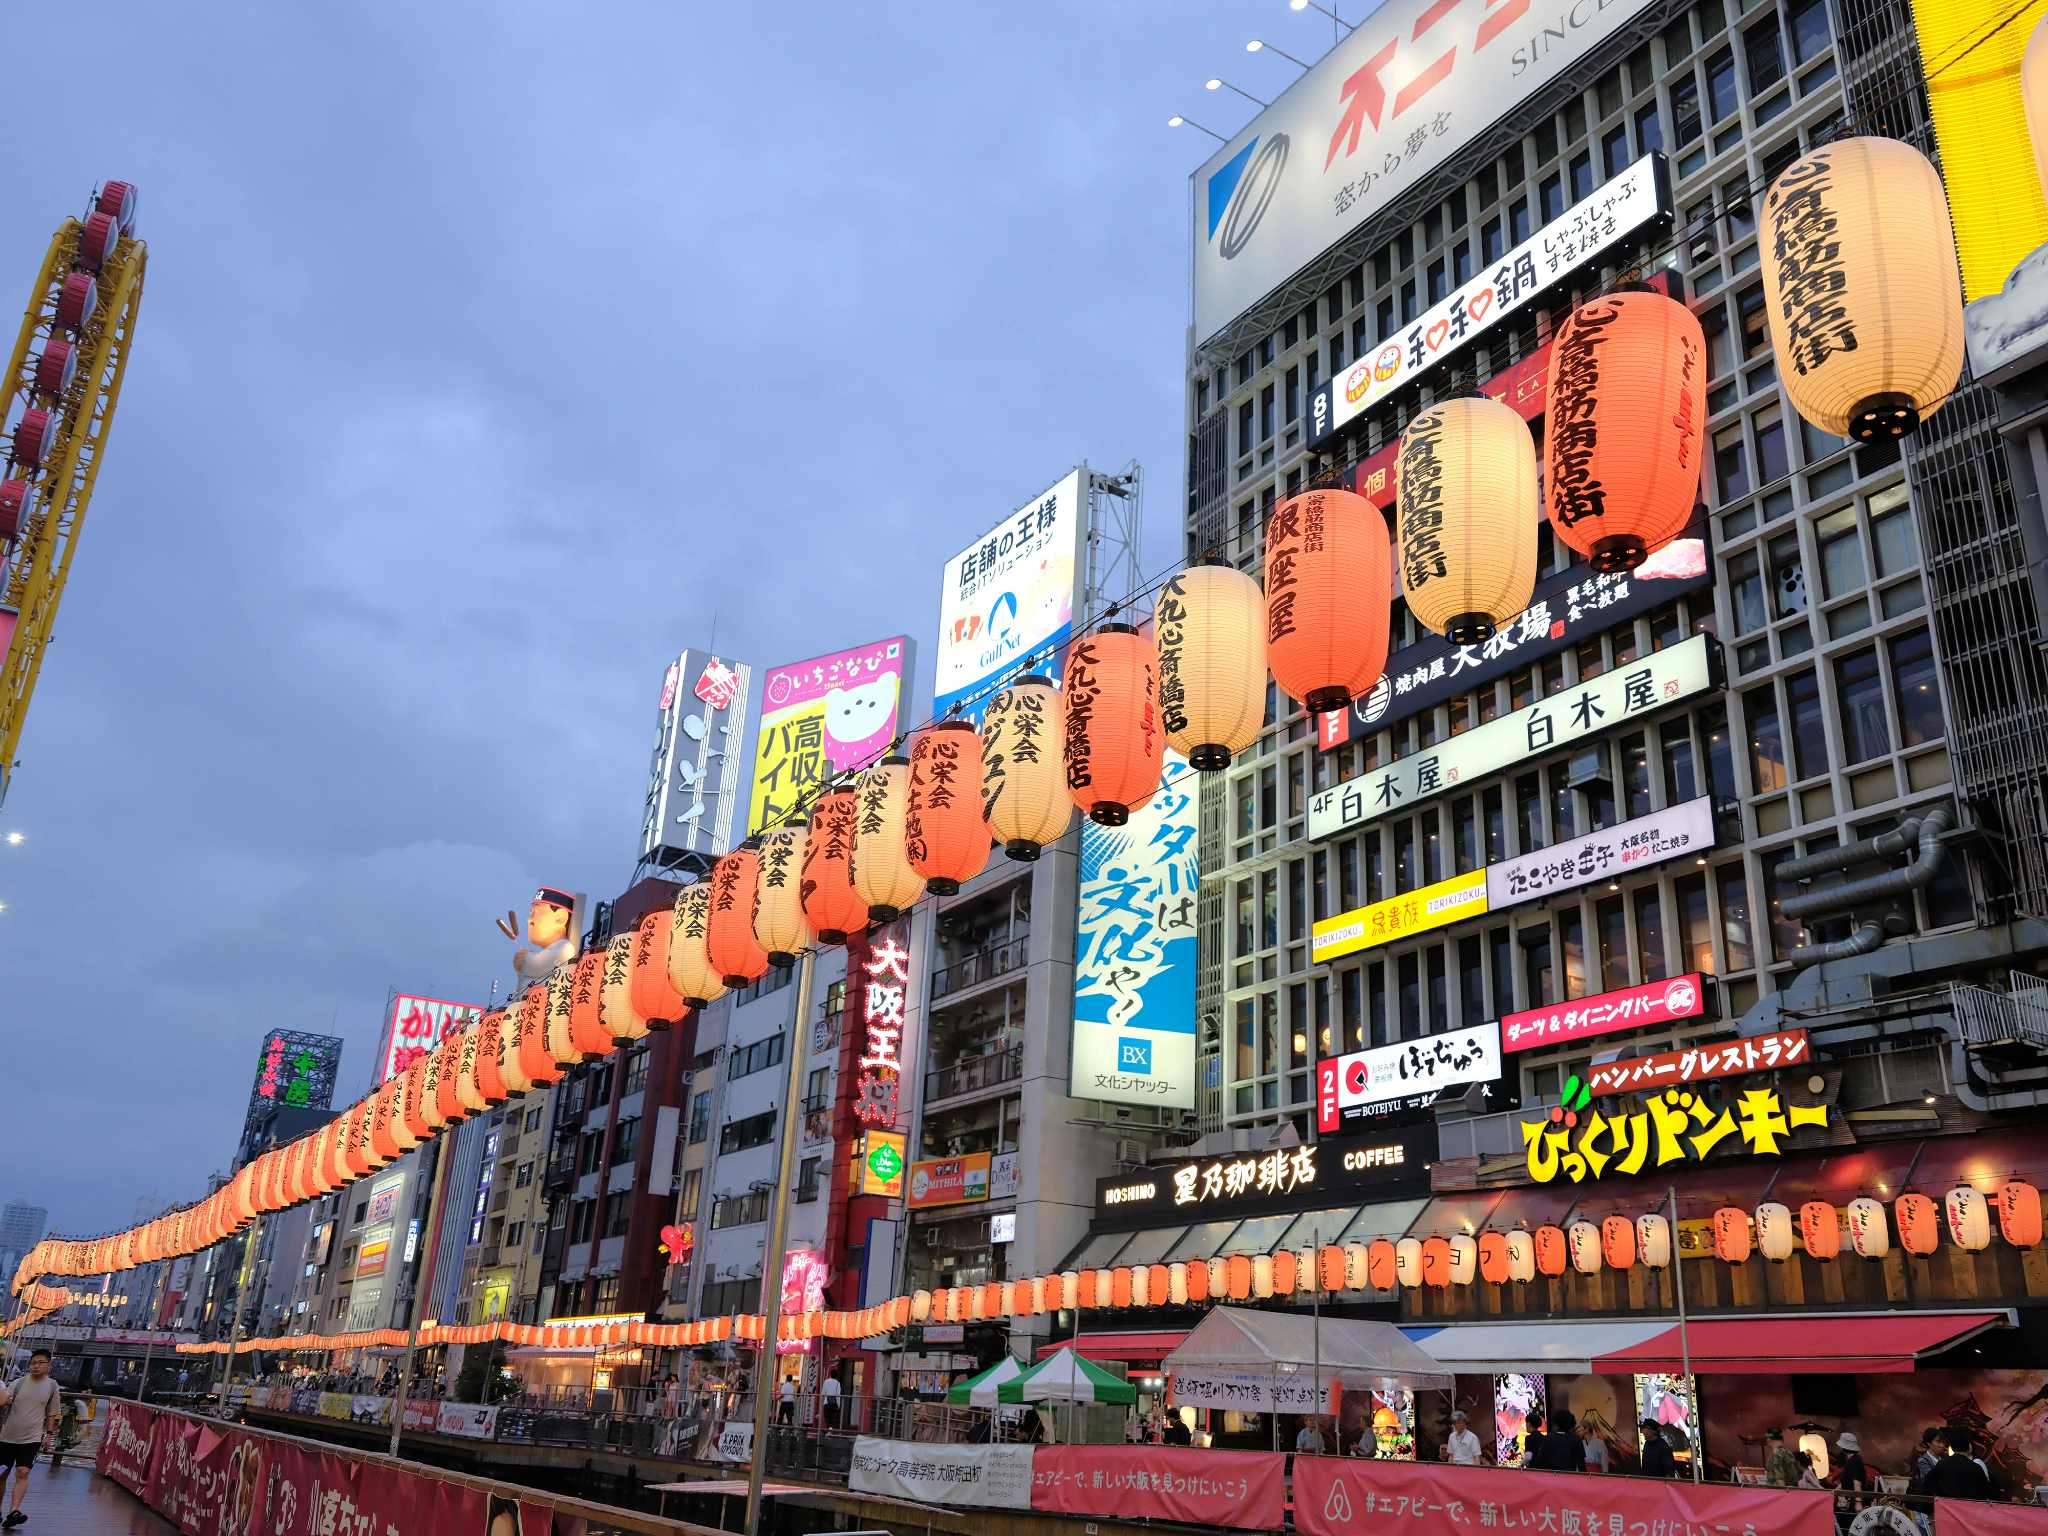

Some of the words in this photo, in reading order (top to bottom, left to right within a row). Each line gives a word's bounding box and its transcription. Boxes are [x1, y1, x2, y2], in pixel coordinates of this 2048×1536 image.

[1334, 111, 1453, 218] 窓から夢を
[1543, 174, 1639, 254] しゃぶしゃぶ
[1546, 216, 1617, 273] すき焼き
[1312, 391, 1328, 437] 8F
[959, 494, 1057, 588] 店舗の王様
[1267, 502, 1300, 645] 銀座屋
[1396, 655, 1446, 698] 焼肉屋
[1449, 600, 1552, 678] 大牧場
[1010, 693, 1045, 764] 心栄会
[1526, 667, 1659, 753] 白木屋
[927, 741, 961, 810] 心栄会
[1312, 794, 1334, 816] 4F
[1341, 755, 1442, 825] 白木屋
[824, 799, 855, 860] 心栄会
[861, 771, 892, 836] 心栄会
[716, 857, 743, 911] 心栄会
[766, 831, 796, 888] 心栄会
[685, 887, 711, 938] 心栄会
[1428, 886, 1481, 912] TORIKIZOKU
[608, 936, 632, 986] 心栄会
[636, 917, 659, 967] 心栄会
[576, 958, 598, 1005] 心栄会
[481, 1017, 501, 1057] 心栄会
[523, 991, 542, 1036] 心栄会
[857, 936, 912, 1128] 大阪王将
[1507, 1018, 1546, 1042] ダーツ
[1549, 1014, 1561, 1033] &
[1563, 994, 1665, 1030] ダイニングバー
[425, 1054, 442, 1092] 心栄会
[460, 1034, 478, 1074] 心栄会
[1122, 1045, 1148, 1065] BX
[1590, 1036, 1807, 1090] ハンバーグレストラン
[1323, 1069, 1334, 1122] 2F
[1344, 1145, 1405, 1171] COFFEE
[1520, 1088, 1829, 1185] びっくりドンキー
[1105, 1183, 1156, 1205] HOSHINO
[1173, 1145, 1319, 1206] 星乃珈琲店
